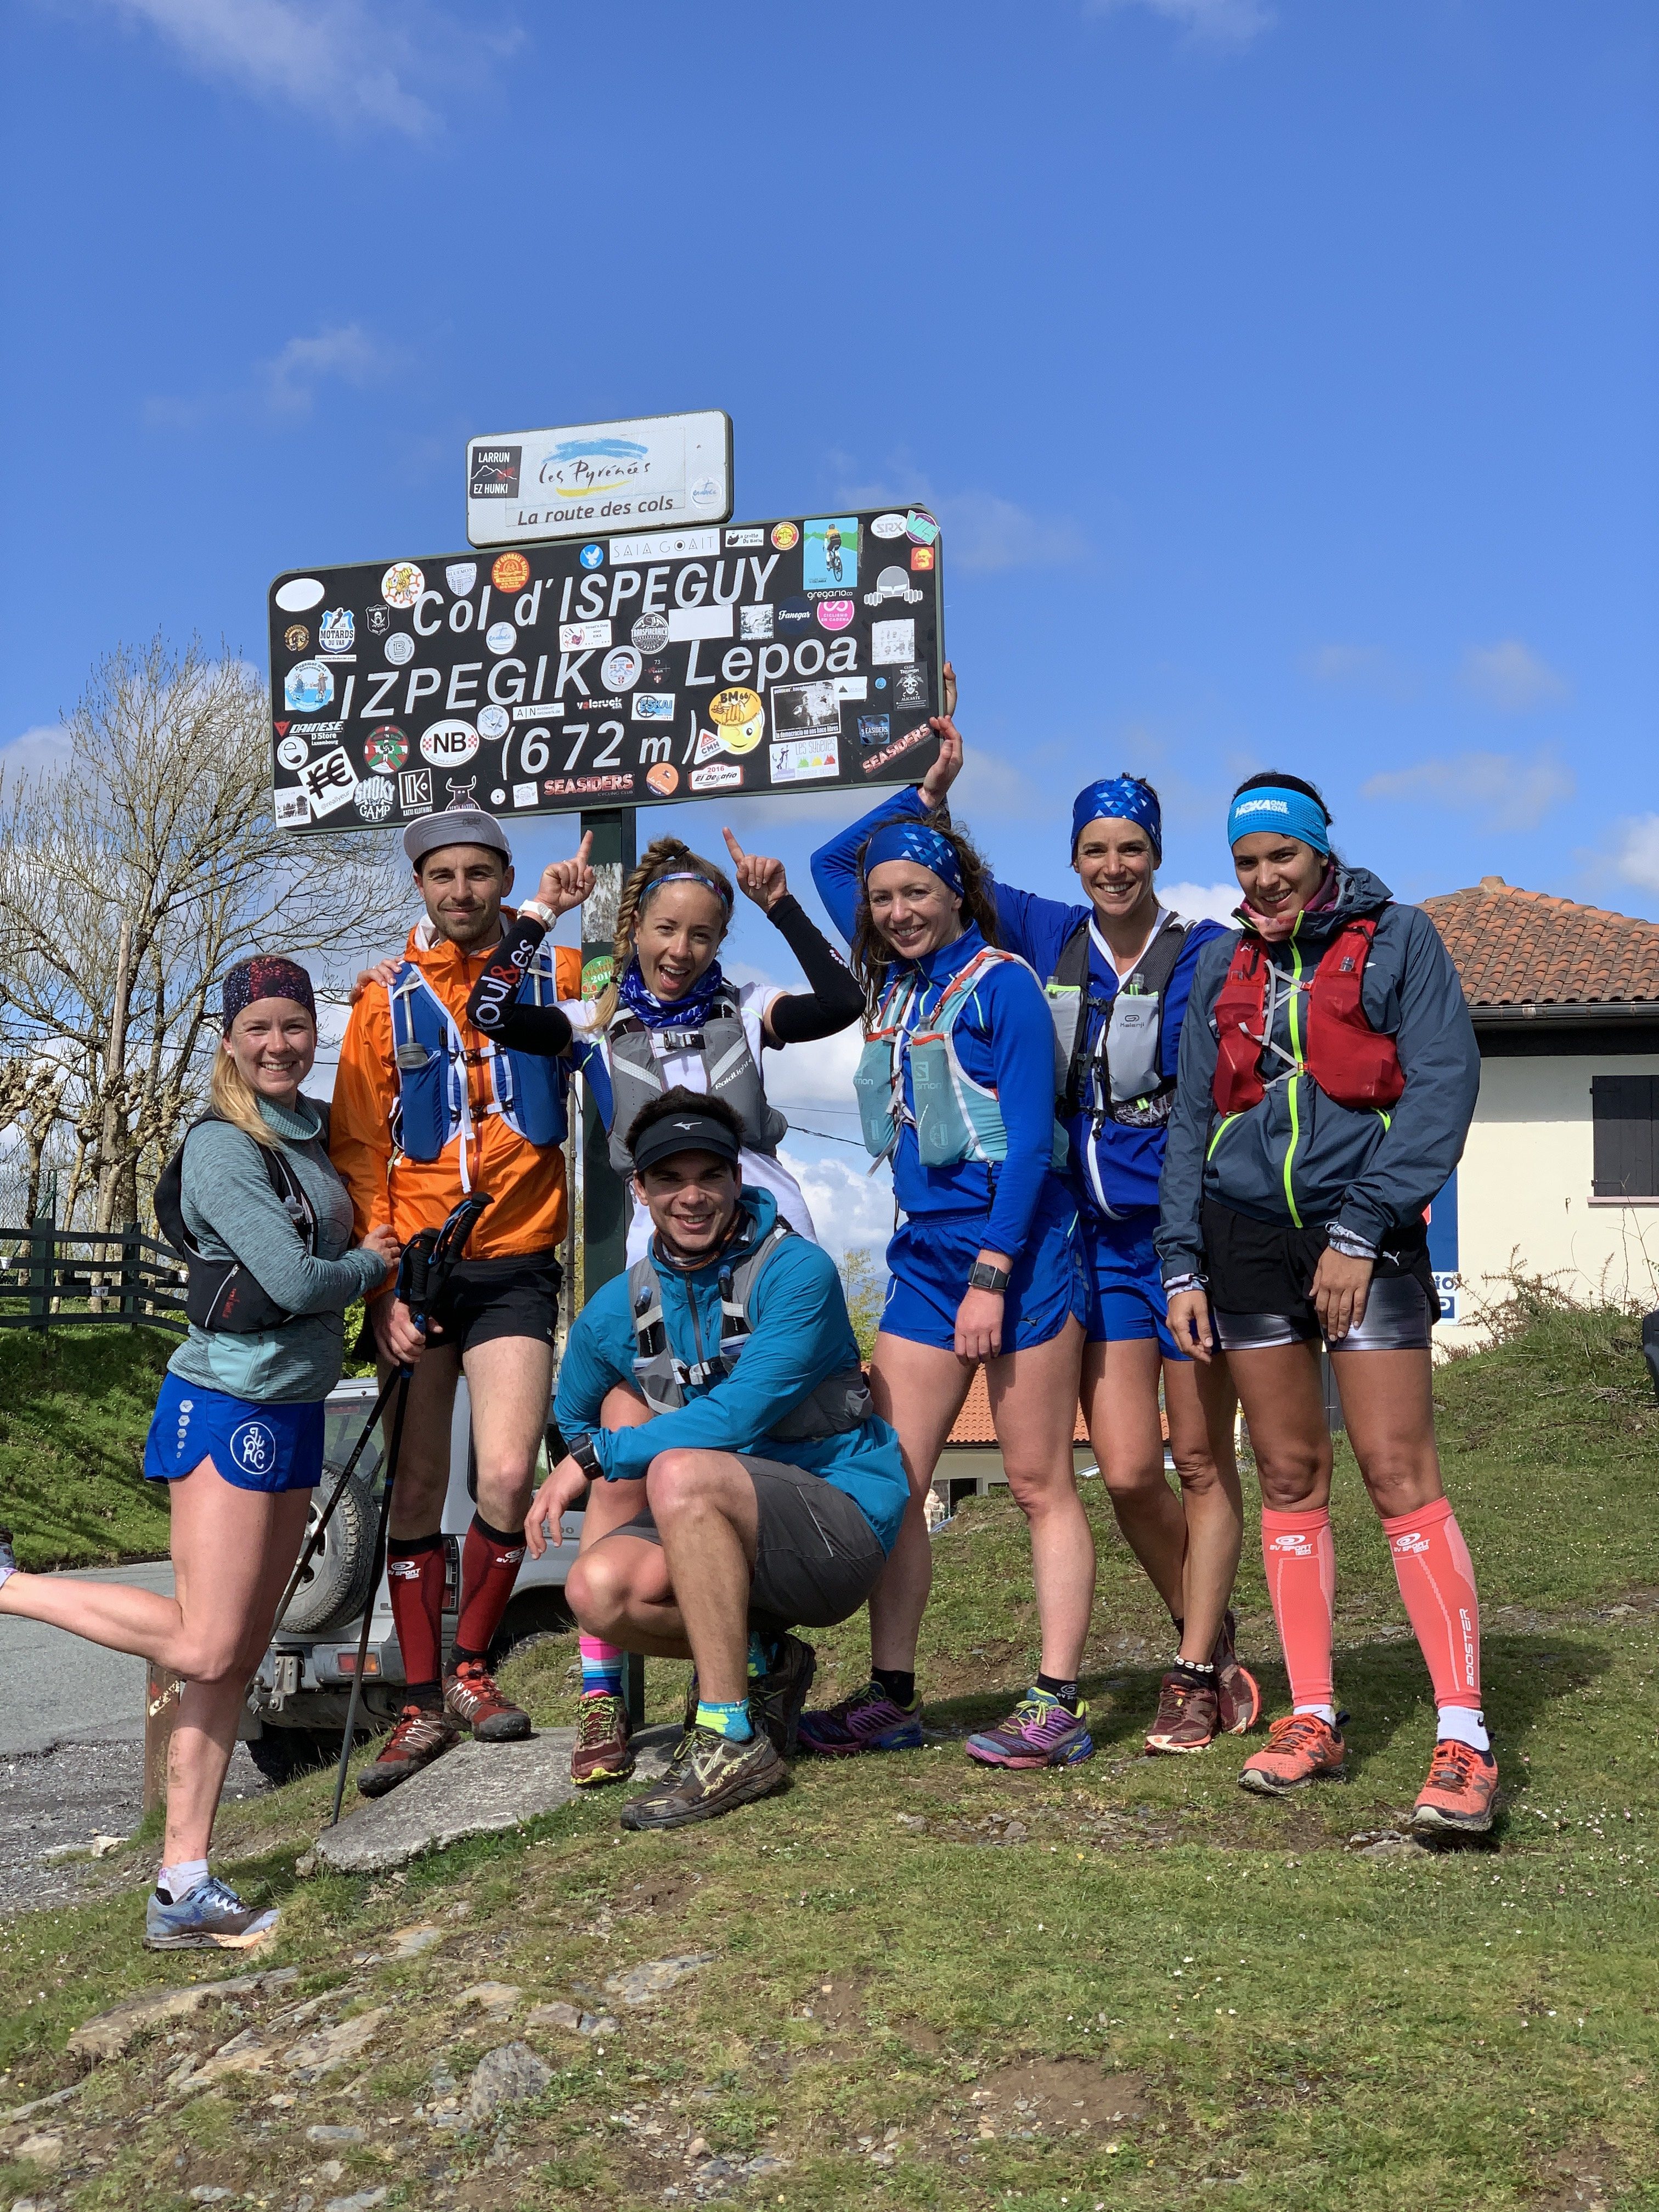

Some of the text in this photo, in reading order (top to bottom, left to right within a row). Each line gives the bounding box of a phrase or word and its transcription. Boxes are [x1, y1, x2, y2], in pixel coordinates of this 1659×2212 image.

[478, 452, 510, 463] LARRUN
[473, 483, 508, 494] EZ HUNKI
[518, 495, 673, 525] La route des cols
[876, 521, 903, 533] SRX
[614, 542, 652, 558] SAIA
[447, 567, 476, 577] BLUEMONT
[413, 553, 781, 637] Col d'ISPEGUY
[778, 610, 811, 621] Fanegas
[320, 630, 354, 639] MOTARDS
[631, 627, 668, 637] TRANSPIRENAICA
[295, 661, 318, 671] Degemer
[340, 645, 642, 720] IZPEGIKO
[685, 636, 858, 693] Lepoa
[720, 691, 738, 703] BM
[640, 699, 673, 709] ESKAI
[289, 721, 344, 734] DAINESE
[861, 726, 888, 735] SEASIDERS
[433, 731, 466, 754] NB
[702, 741, 720, 754] CMH
[795, 742, 806, 755] Les
[862, 723, 930, 774] SEASIDERS
[354, 775, 396, 803] SMOKY
[544, 773, 634, 795] SEASIDERS
[359, 804, 391, 820] CAMP
[1234, 799, 1288, 819] HOKA ONE
[1271, 805, 1288, 815] ONE
[715, 1060, 748, 1091] RaidLight
[1282, 1543, 1313, 1551] SPORT
[1402, 1539, 1431, 1552] SPORT
[395, 1567, 421, 1576] SPORT
[1459, 1608, 1475, 1688] BOOSTER
